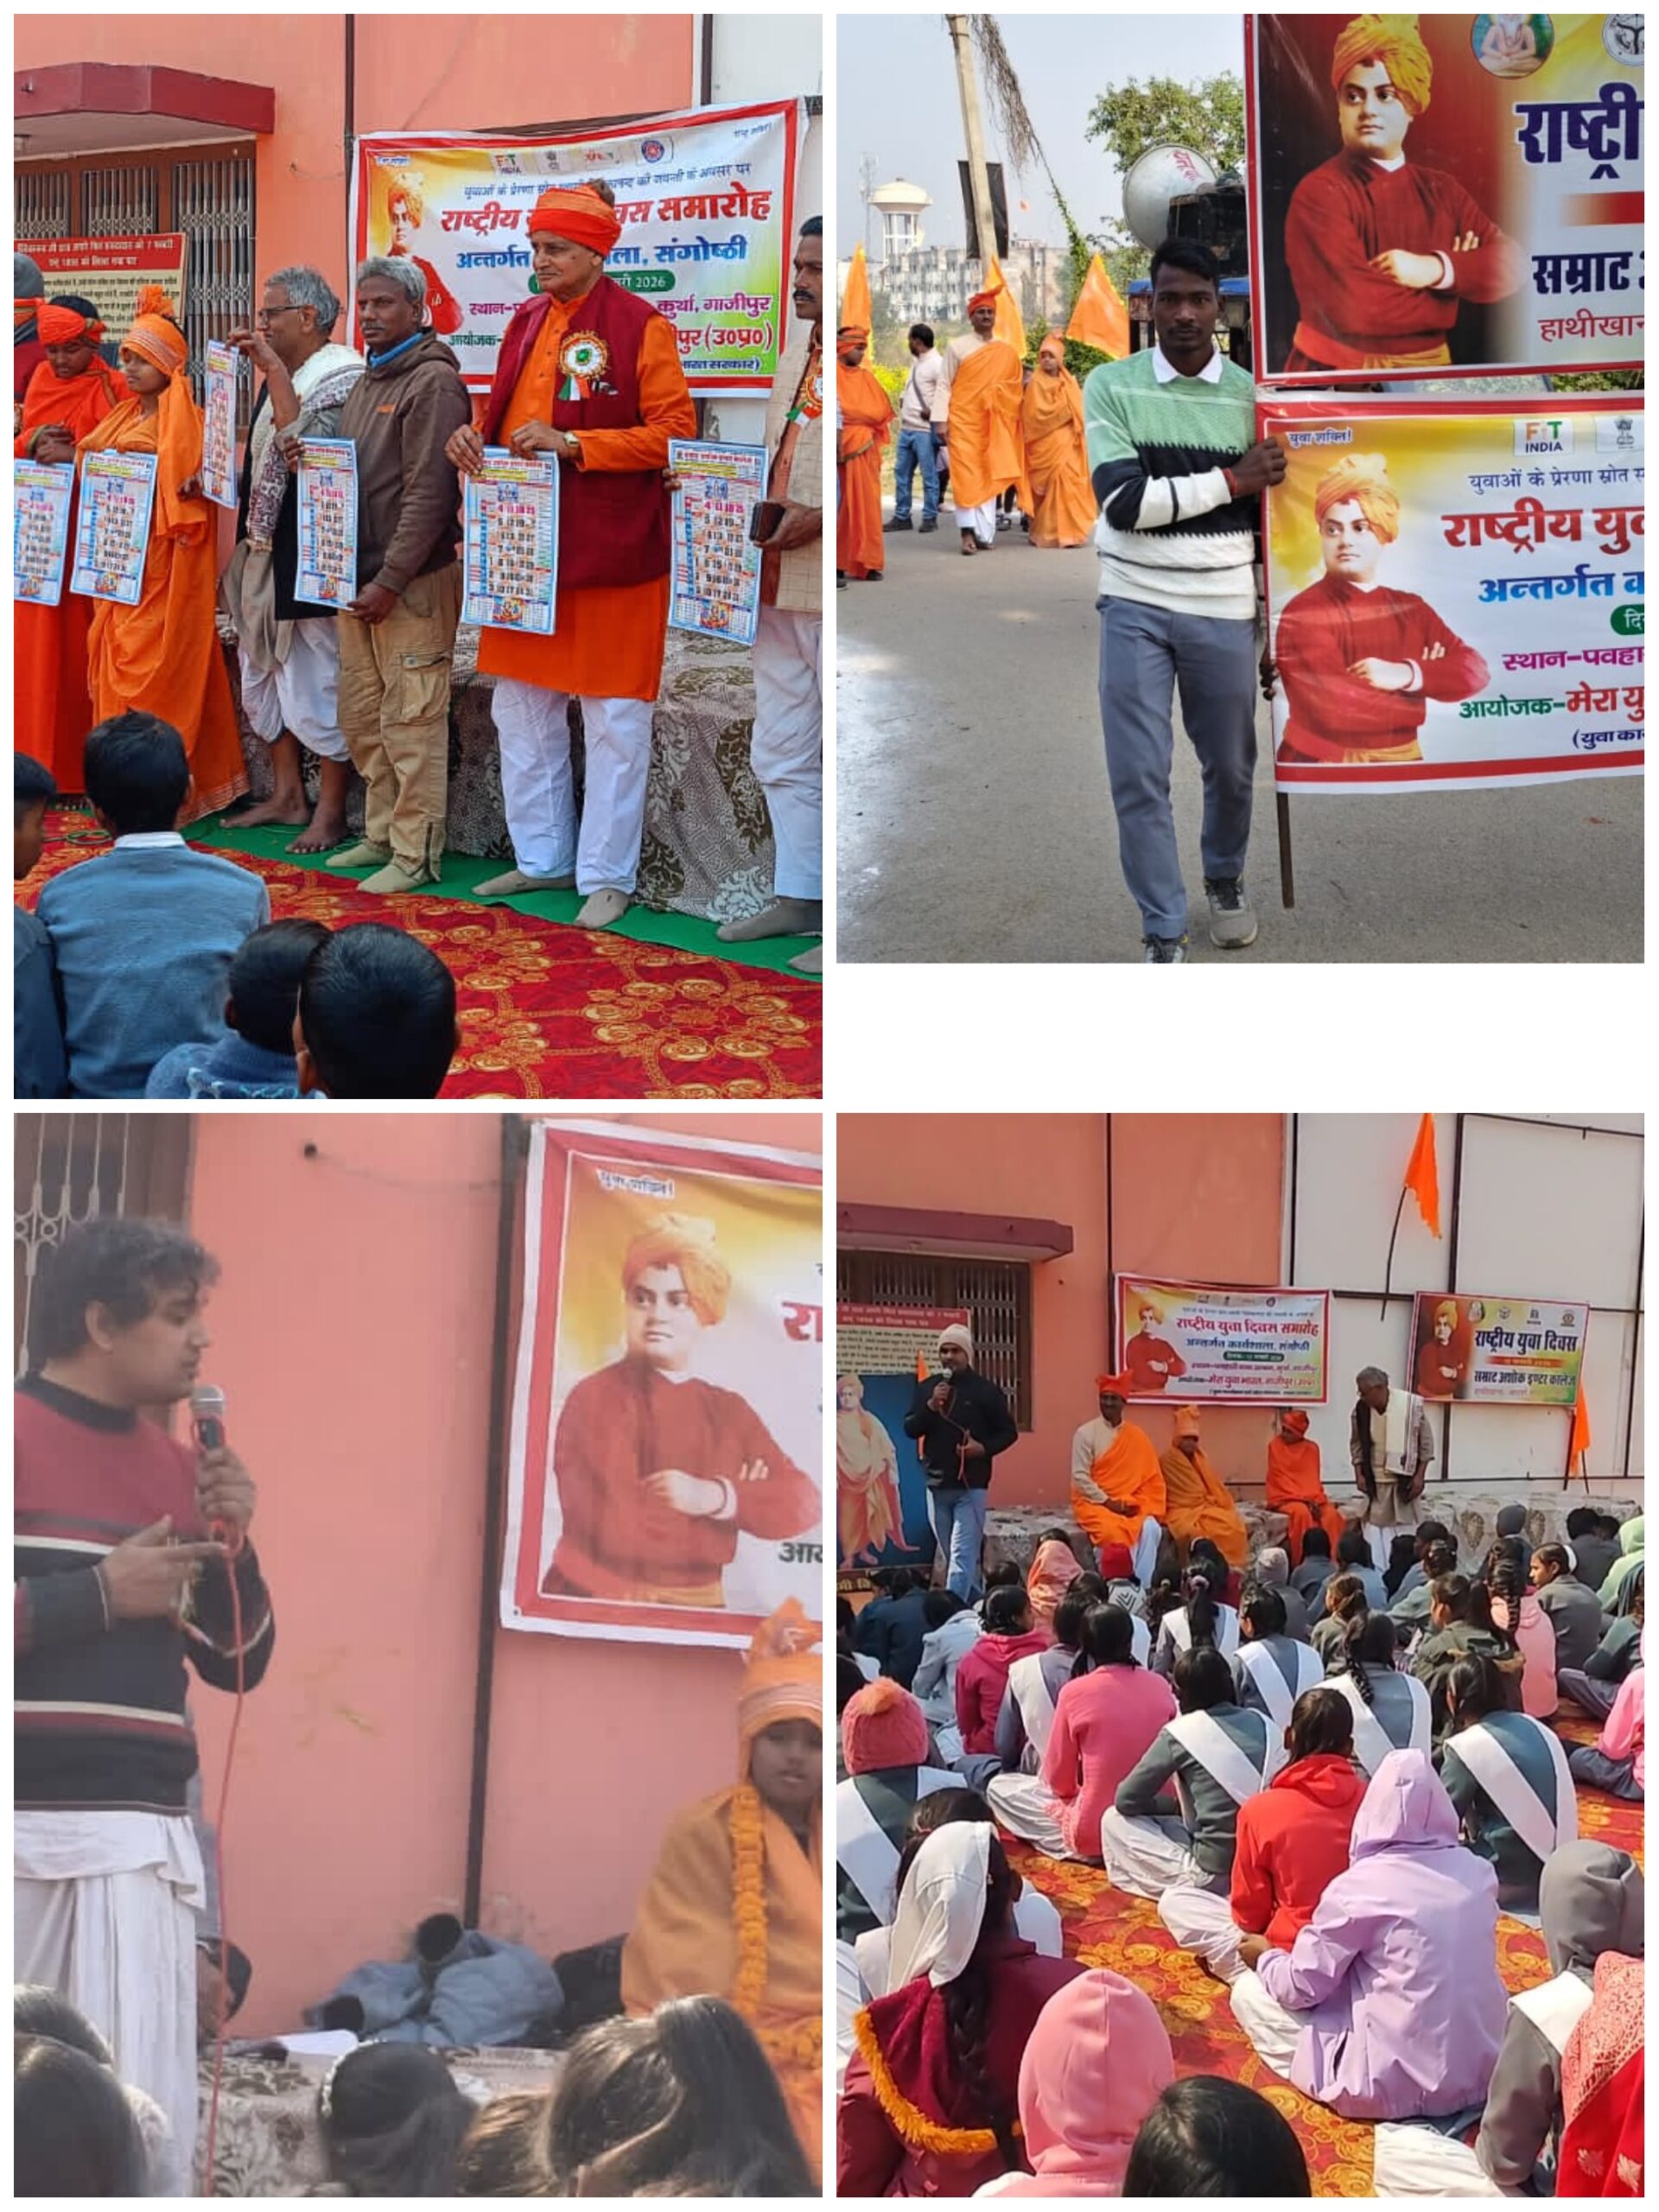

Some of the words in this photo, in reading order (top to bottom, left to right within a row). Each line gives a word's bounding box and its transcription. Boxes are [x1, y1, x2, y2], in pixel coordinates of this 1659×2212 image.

[441, 201, 520, 237] राष्ट्रीय
[657, 181, 772, 222] समारोह
[456, 245, 530, 269] अन्तर्गत
[654, 234, 747, 264] संगोष्ठी
[636, 276, 667, 289] 2026
[1532, 251, 1633, 295] सम्राट
[702, 292, 772, 319] गाजीपुर
[1526, 442, 1563, 454] INDIA
[1468, 467, 1522, 495] युवाओं
[1527, 467, 1545, 486] के
[1549, 467, 1594, 487] प्रेरणा
[1597, 464, 1629, 483] स्रोत
[1441, 497, 1583, 554] राष्ट्रीय
[1478, 563, 1615, 602] अन्तर्गत
[1502, 646, 1644, 671] स्थान-पवहा
[1176, 1316, 1215, 1333] राष्ट्रीय
[1217, 1320, 1242, 1336] युवा
[1244, 1318, 1278, 1334] दिवस
[1475, 1326, 1515, 1353] राष्ट्रीय
[1517, 1332, 1541, 1355] युवा
[1544, 1329, 1578, 1352] दिवस
[1474, 1370, 1497, 1383] सम्राट
[1498, 1369, 1526, 1383] अशोक
